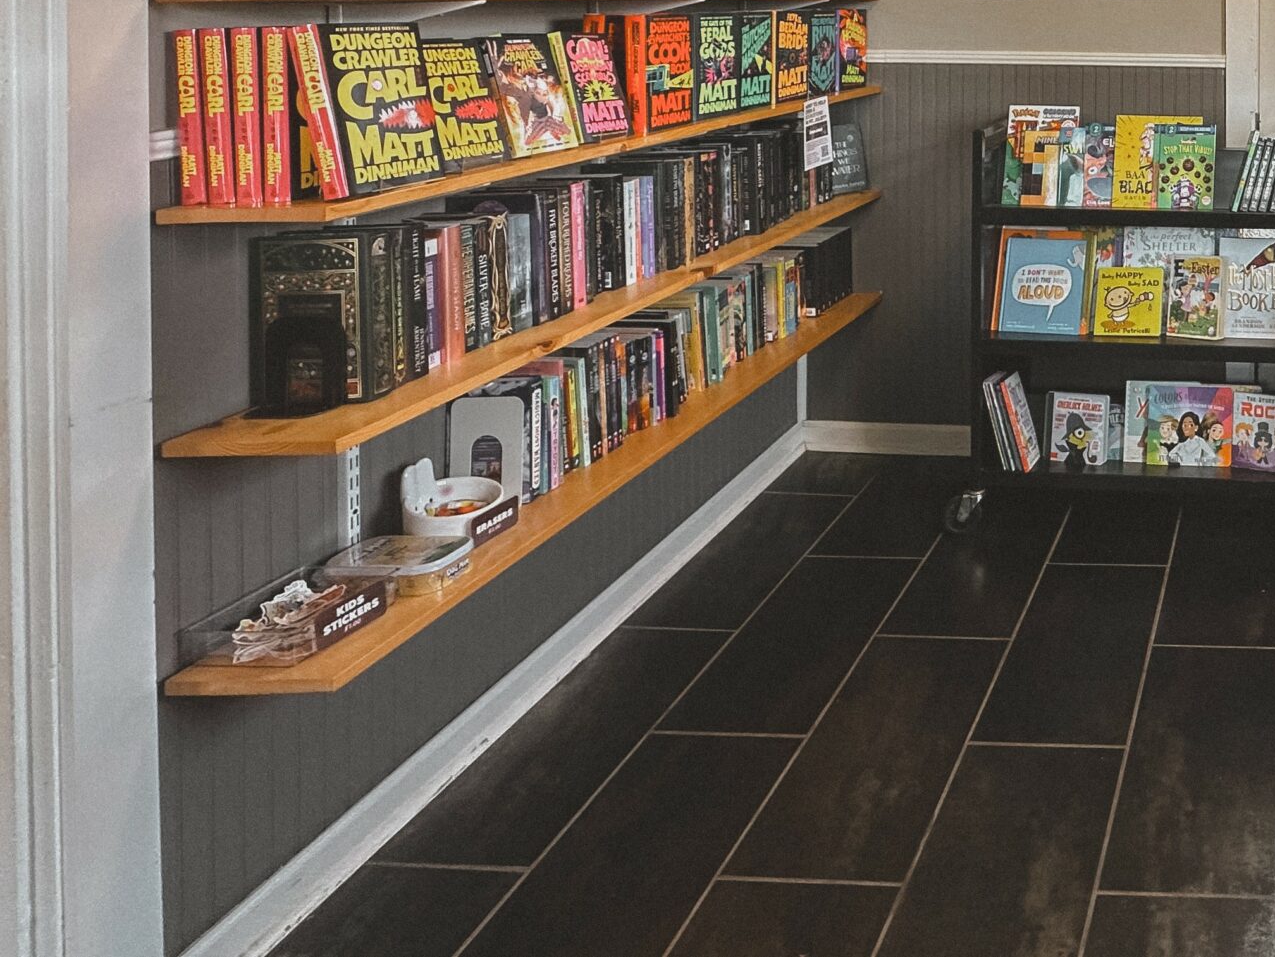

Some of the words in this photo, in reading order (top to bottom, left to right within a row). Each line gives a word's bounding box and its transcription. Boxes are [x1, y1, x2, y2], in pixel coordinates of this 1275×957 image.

[650, 21, 690, 34] DUNGEON
[701, 26, 734, 44] FERAL
[329, 32, 417, 51] DUNGEON
[779, 32, 809, 50] BRIDE
[332, 49, 421, 71] CRAWLER
[422, 47, 477, 62] UNGEON
[504, 50, 546, 63] CRAWLER
[425, 60, 481, 77] RAWLER
[778, 65, 808, 88] MATT
[846, 64, 859, 75] MATT
[179, 75, 196, 118] CARL
[207, 75, 225, 117] CARL
[237, 74, 254, 116] CARL
[267, 73, 285, 116] CARL
[304, 71, 326, 114] CARL
[337, 67, 427, 121] CARL
[428, 74, 489, 114] CARL
[700, 78, 737, 103] MATT
[740, 74, 771, 97] MATT
[778, 83, 808, 98] DINNIMAN
[582, 99, 625, 123] MATT
[651, 89, 691, 116] MATT
[699, 98, 737, 115] DINNIMAN
[740, 93, 770, 107] DINNIMAN
[585, 119, 629, 134] DINNIMAN
[651, 109, 691, 128] DINNIMAN
[435, 115, 499, 149] MATT
[345, 120, 434, 169] MATT
[442, 140, 504, 161] DINNIMAN
[1163, 145, 1177, 155] STOP
[1178, 144, 1193, 154] THAT
[354, 155, 440, 185] DINNIMAN
[1125, 171, 1146, 180] BAA
[562, 201, 570, 227] FOUR
[549, 230, 558, 266] BROKEN
[562, 228, 571, 262] RUINED
[1143, 241, 1197, 252] SHELTER
[1161, 232, 1192, 242] perfect
[478, 253, 488, 292] SILVER
[1174, 258, 1185, 277] E
[1191, 260, 1220, 275] Easter
[413, 274, 421, 301] FLAME
[551, 268, 559, 303] BLADES
[564, 263, 572, 298] REALMS
[1017, 284, 1065, 301] ALOUD
[479, 299, 490, 331] BONE
[475, 507, 514, 535] ERASERS
[323, 597, 380, 637] STICKERS
[336, 593, 365, 617] KIDS
